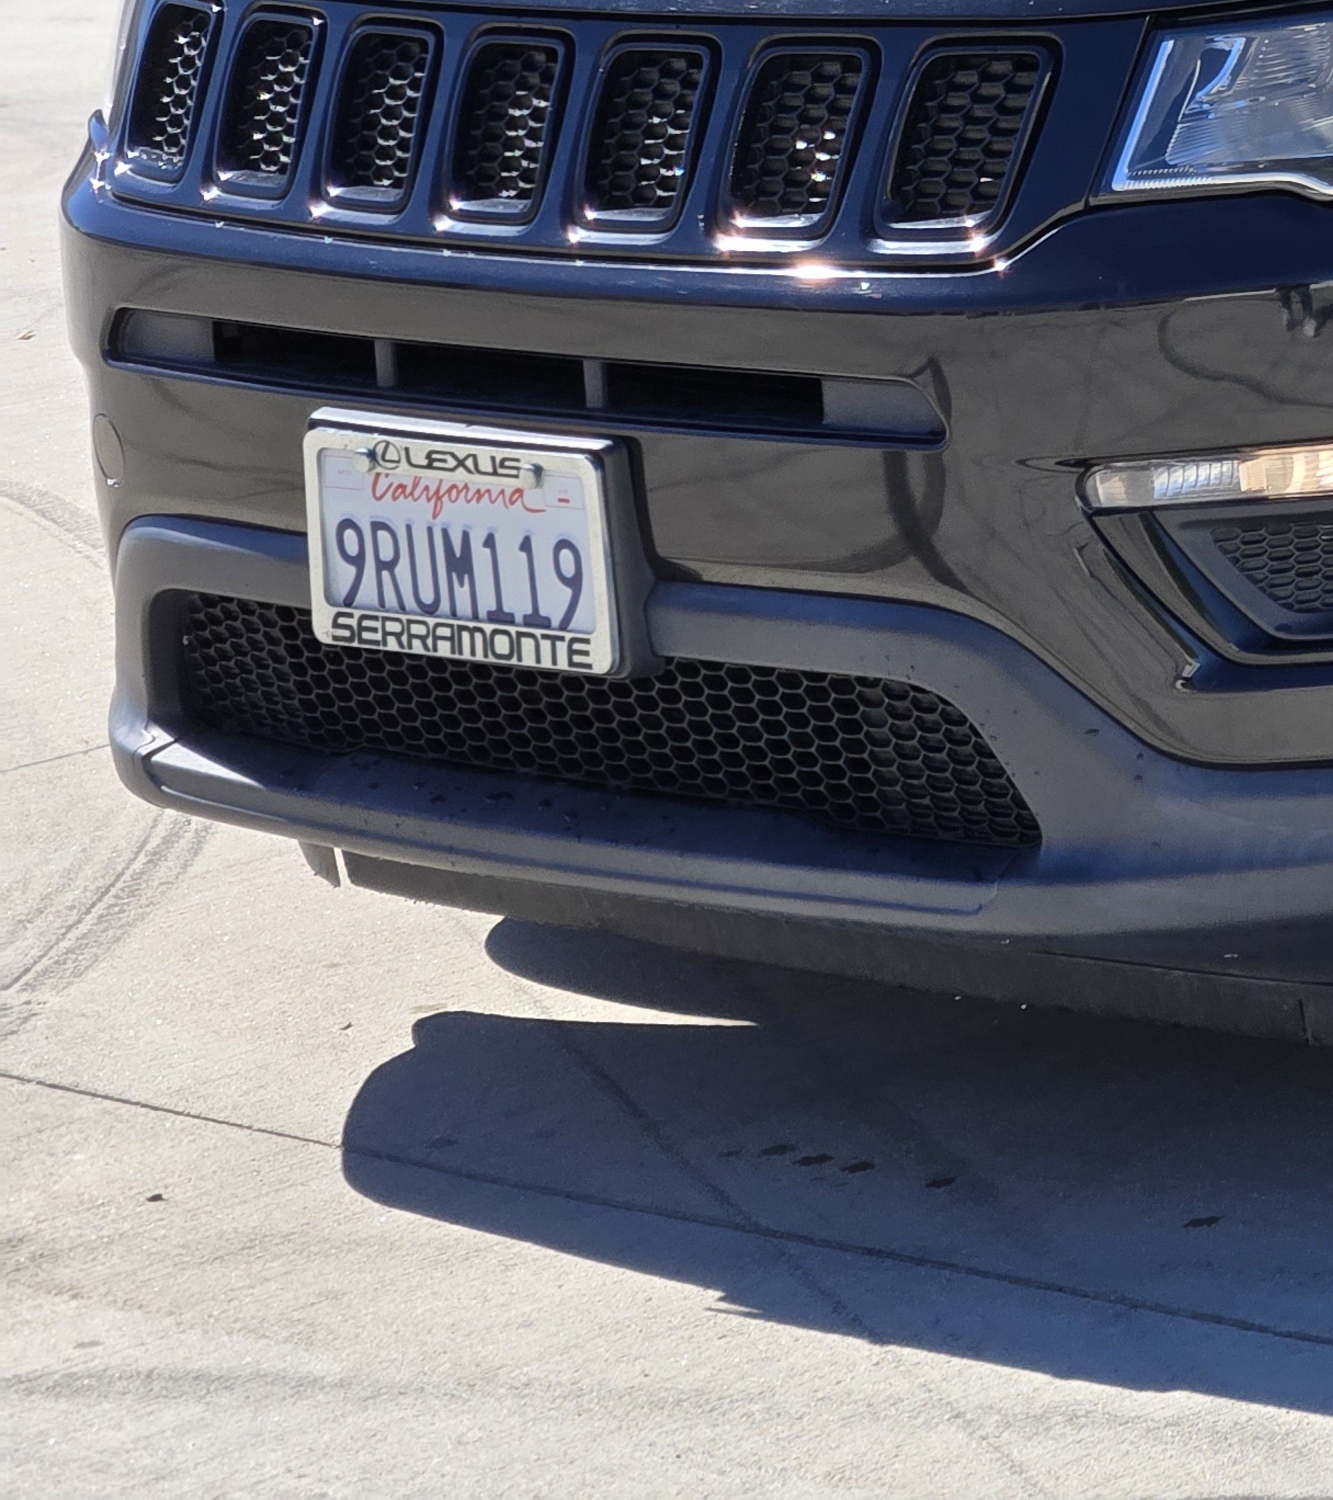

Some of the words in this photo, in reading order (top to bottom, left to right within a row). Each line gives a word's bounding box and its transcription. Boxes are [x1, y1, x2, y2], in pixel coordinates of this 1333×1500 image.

[403, 446, 521, 479] LEXUS
[371, 472, 547, 520] California
[335, 517, 584, 631] 9RUM119
[331, 611, 594, 671] SERRAMONTE
